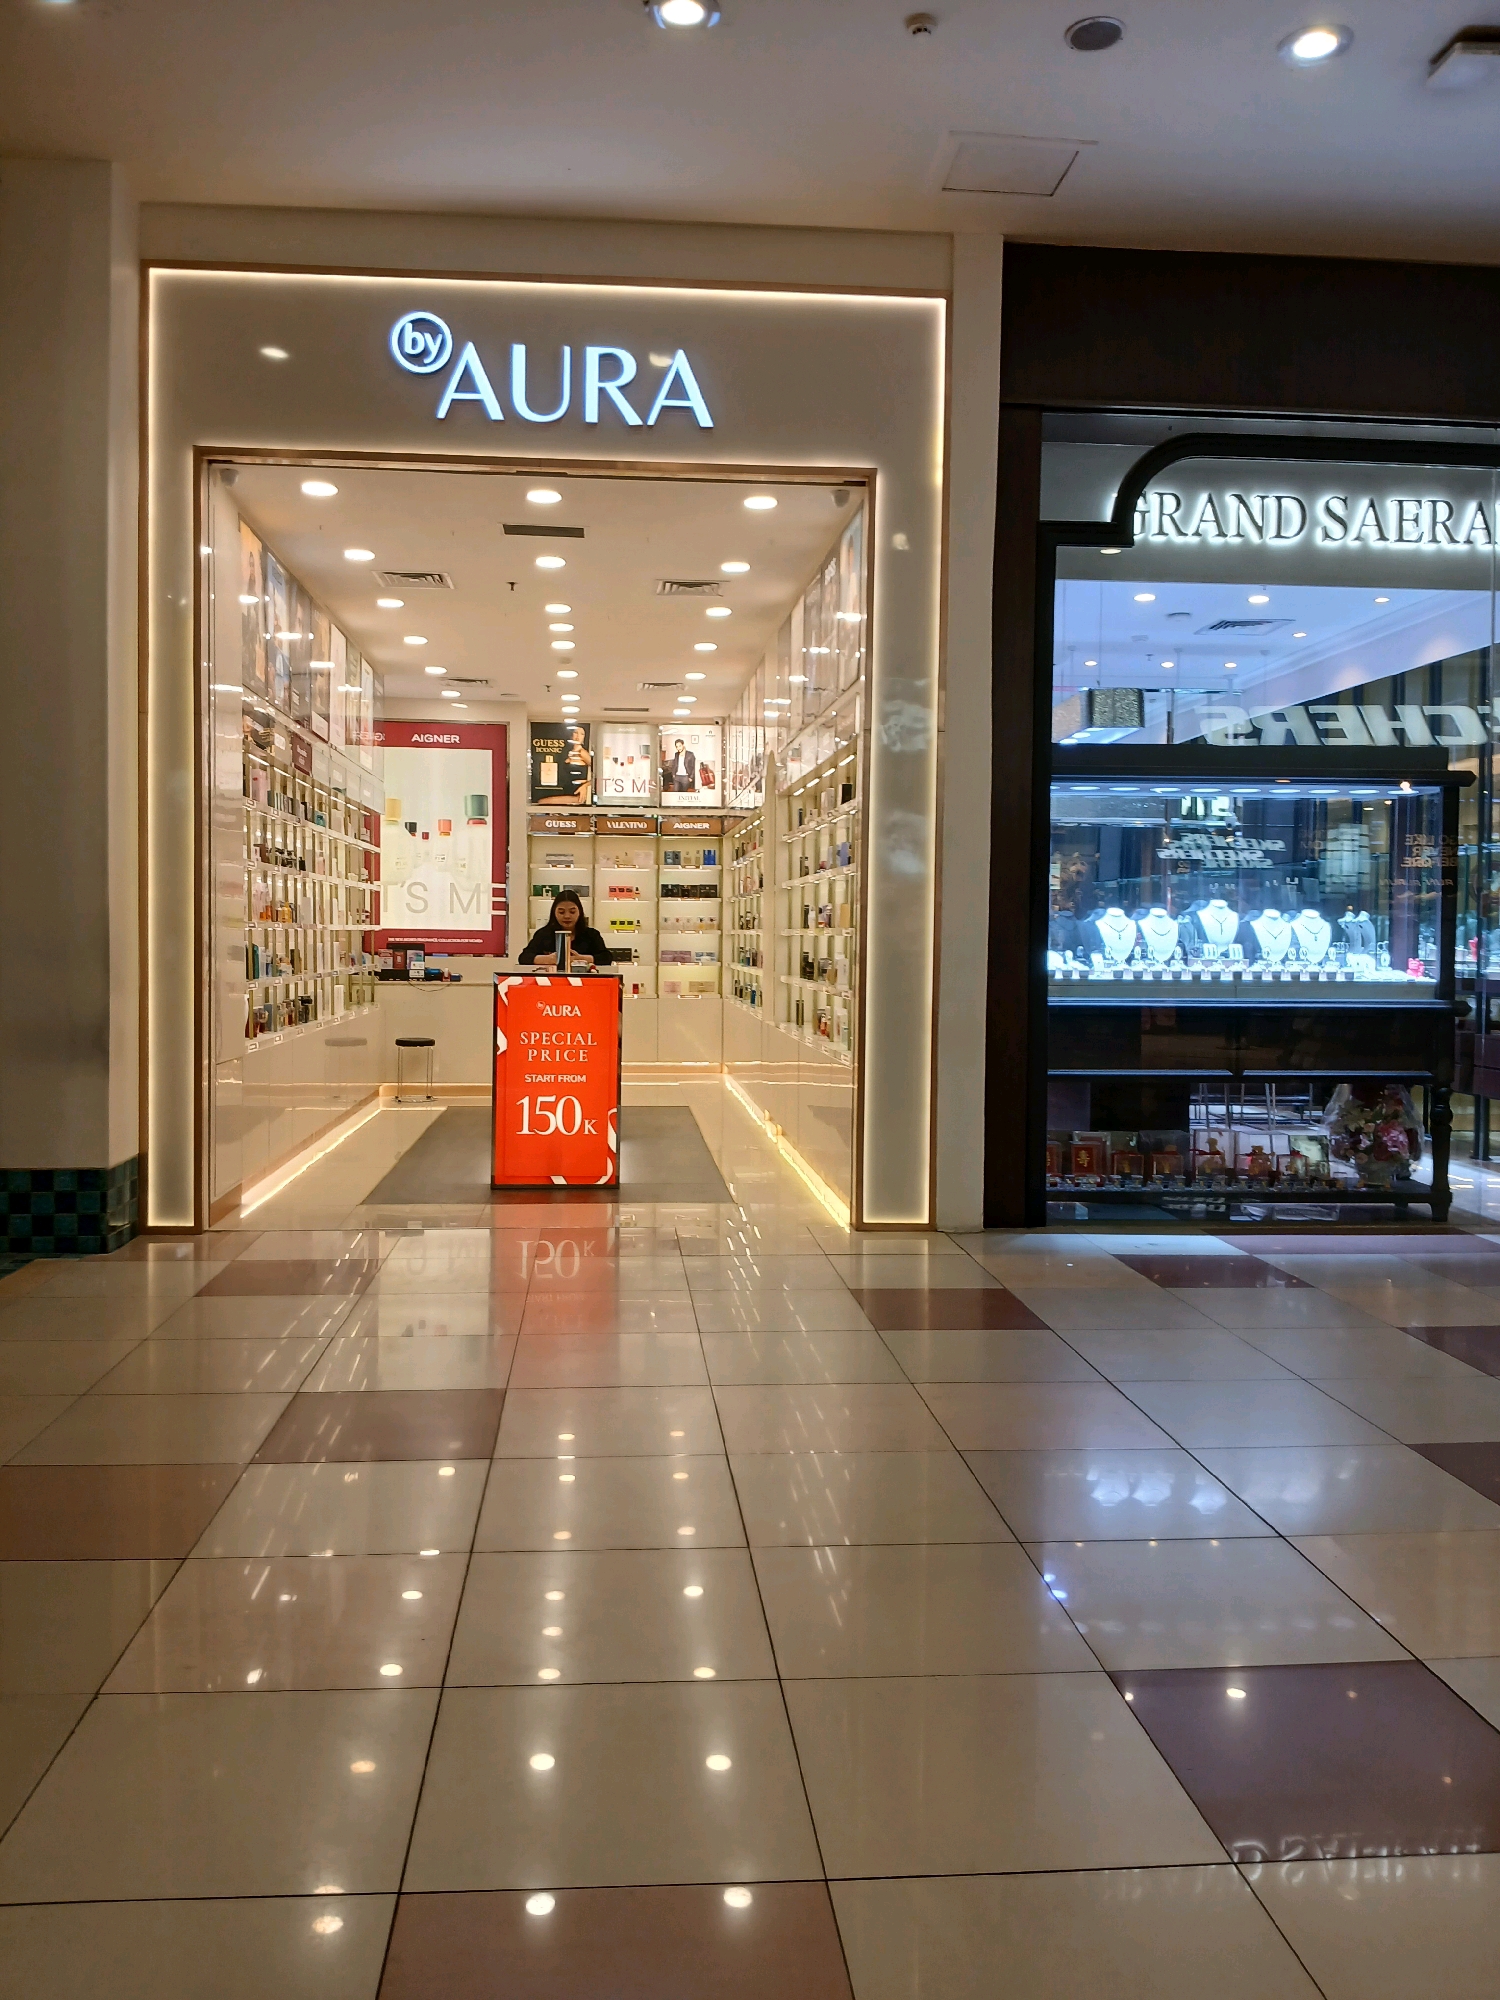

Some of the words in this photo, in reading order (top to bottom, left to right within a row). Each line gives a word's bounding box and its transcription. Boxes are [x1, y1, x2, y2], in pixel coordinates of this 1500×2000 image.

[401, 319, 446, 366] by
[436, 341, 714, 428] AURA
[1321, 495, 1499, 544] SAERA
[411, 733, 460, 744] AIGNER
[532, 738, 565, 747] GUESS
[545, 820, 577, 828] GUESS
[606, 820, 648, 829] VALENTINO
[542, 1004, 582, 1017] AURA
[520, 1031, 597, 1046] SPECIAL
[527, 1049, 588, 1062] PRICE
[524, 1074, 555, 1083] START
[558, 1074, 586, 1083] FROM
[516, 1095, 598, 1136] 150K
